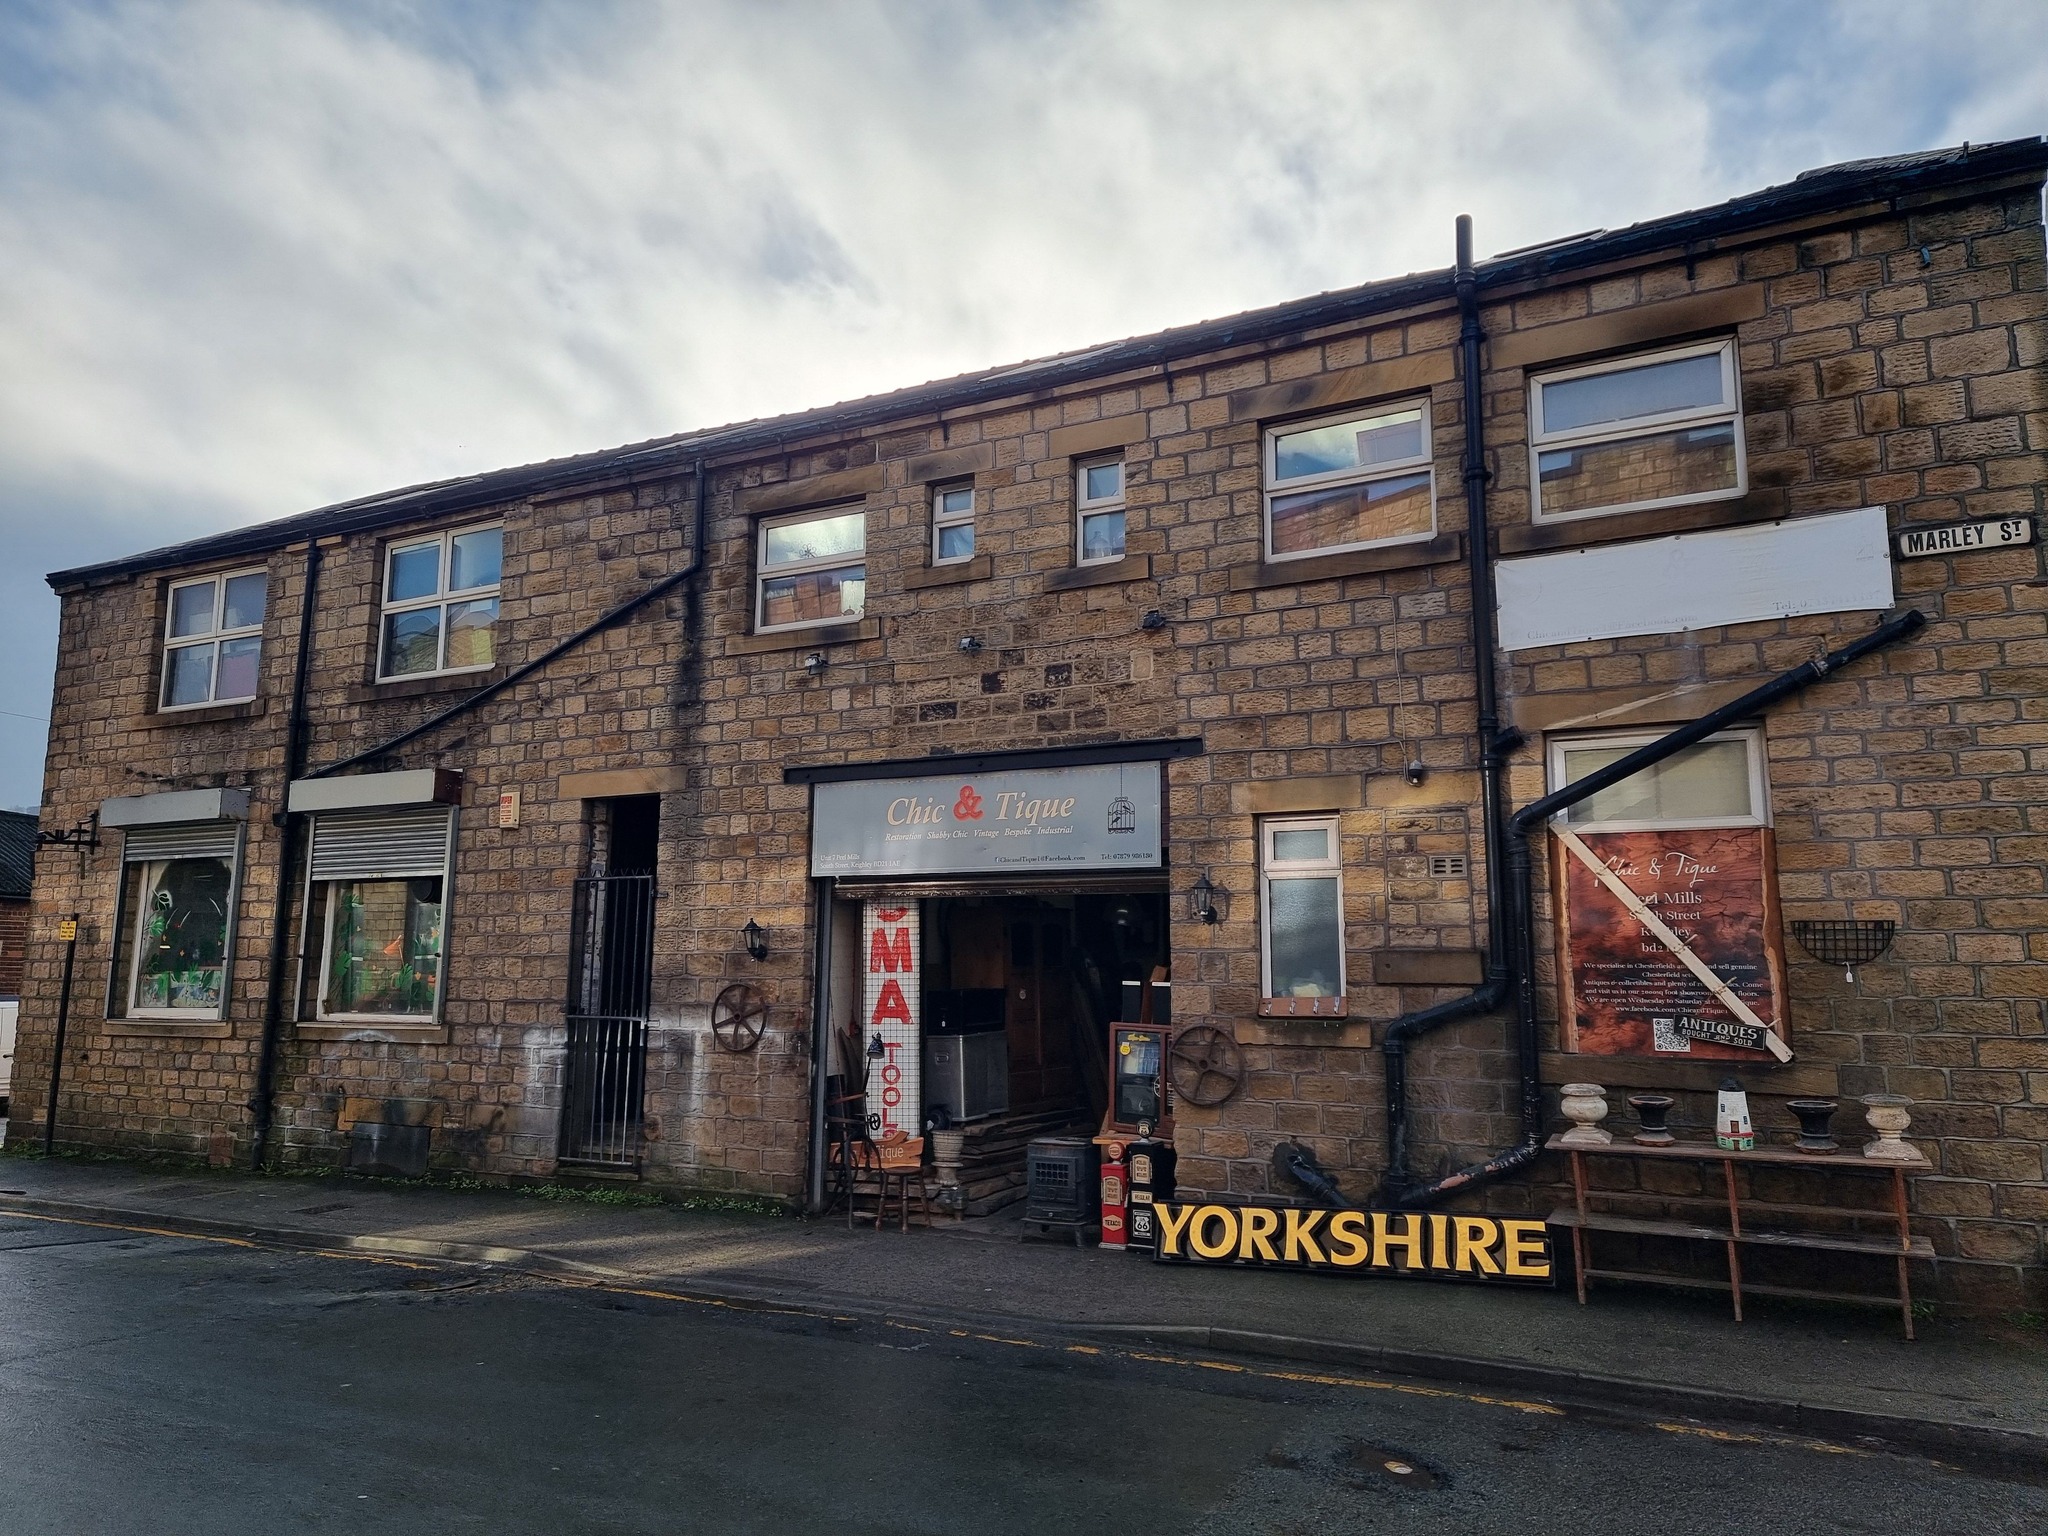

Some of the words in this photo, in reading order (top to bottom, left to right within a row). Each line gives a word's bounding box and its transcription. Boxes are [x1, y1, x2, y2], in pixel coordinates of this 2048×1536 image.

[1907, 525, 1985, 553] MARLEY
[887, 796, 946, 827] Chic
[953, 785, 984, 822] &
[996, 791, 1076, 827] Tique
[885, 833, 922, 842] Restoration
[926, 830, 951, 841] Shabby
[952, 829, 969, 839] Chic
[974, 828, 1000, 838] Vintage
[1004, 827, 1032, 837] Bespoke
[1037, 825, 1074, 835] Industrial
[1648, 857, 1664, 880] &
[1665, 852, 1719, 888] Tique
[1664, 892, 1702, 904] Mills
[1666, 910, 1701, 920] Street
[1597, 962, 1626, 970] specialise
[1730, 963, 1758, 971] genuine
[1583, 979, 1610, 987] Antiques
[1627, 997, 1665, 1005] Wednesday
[1674, 998, 1703, 1006] Saturday
[1679, 1016, 1758, 1040] ANTIQUES
[1681, 1028, 1711, 1039] BOUGHT
[1733, 1037, 1753, 1047] SOLD
[1136, 1222, 1148, 1230] 66
[1153, 1203, 1551, 1278] YORKSHIRE
